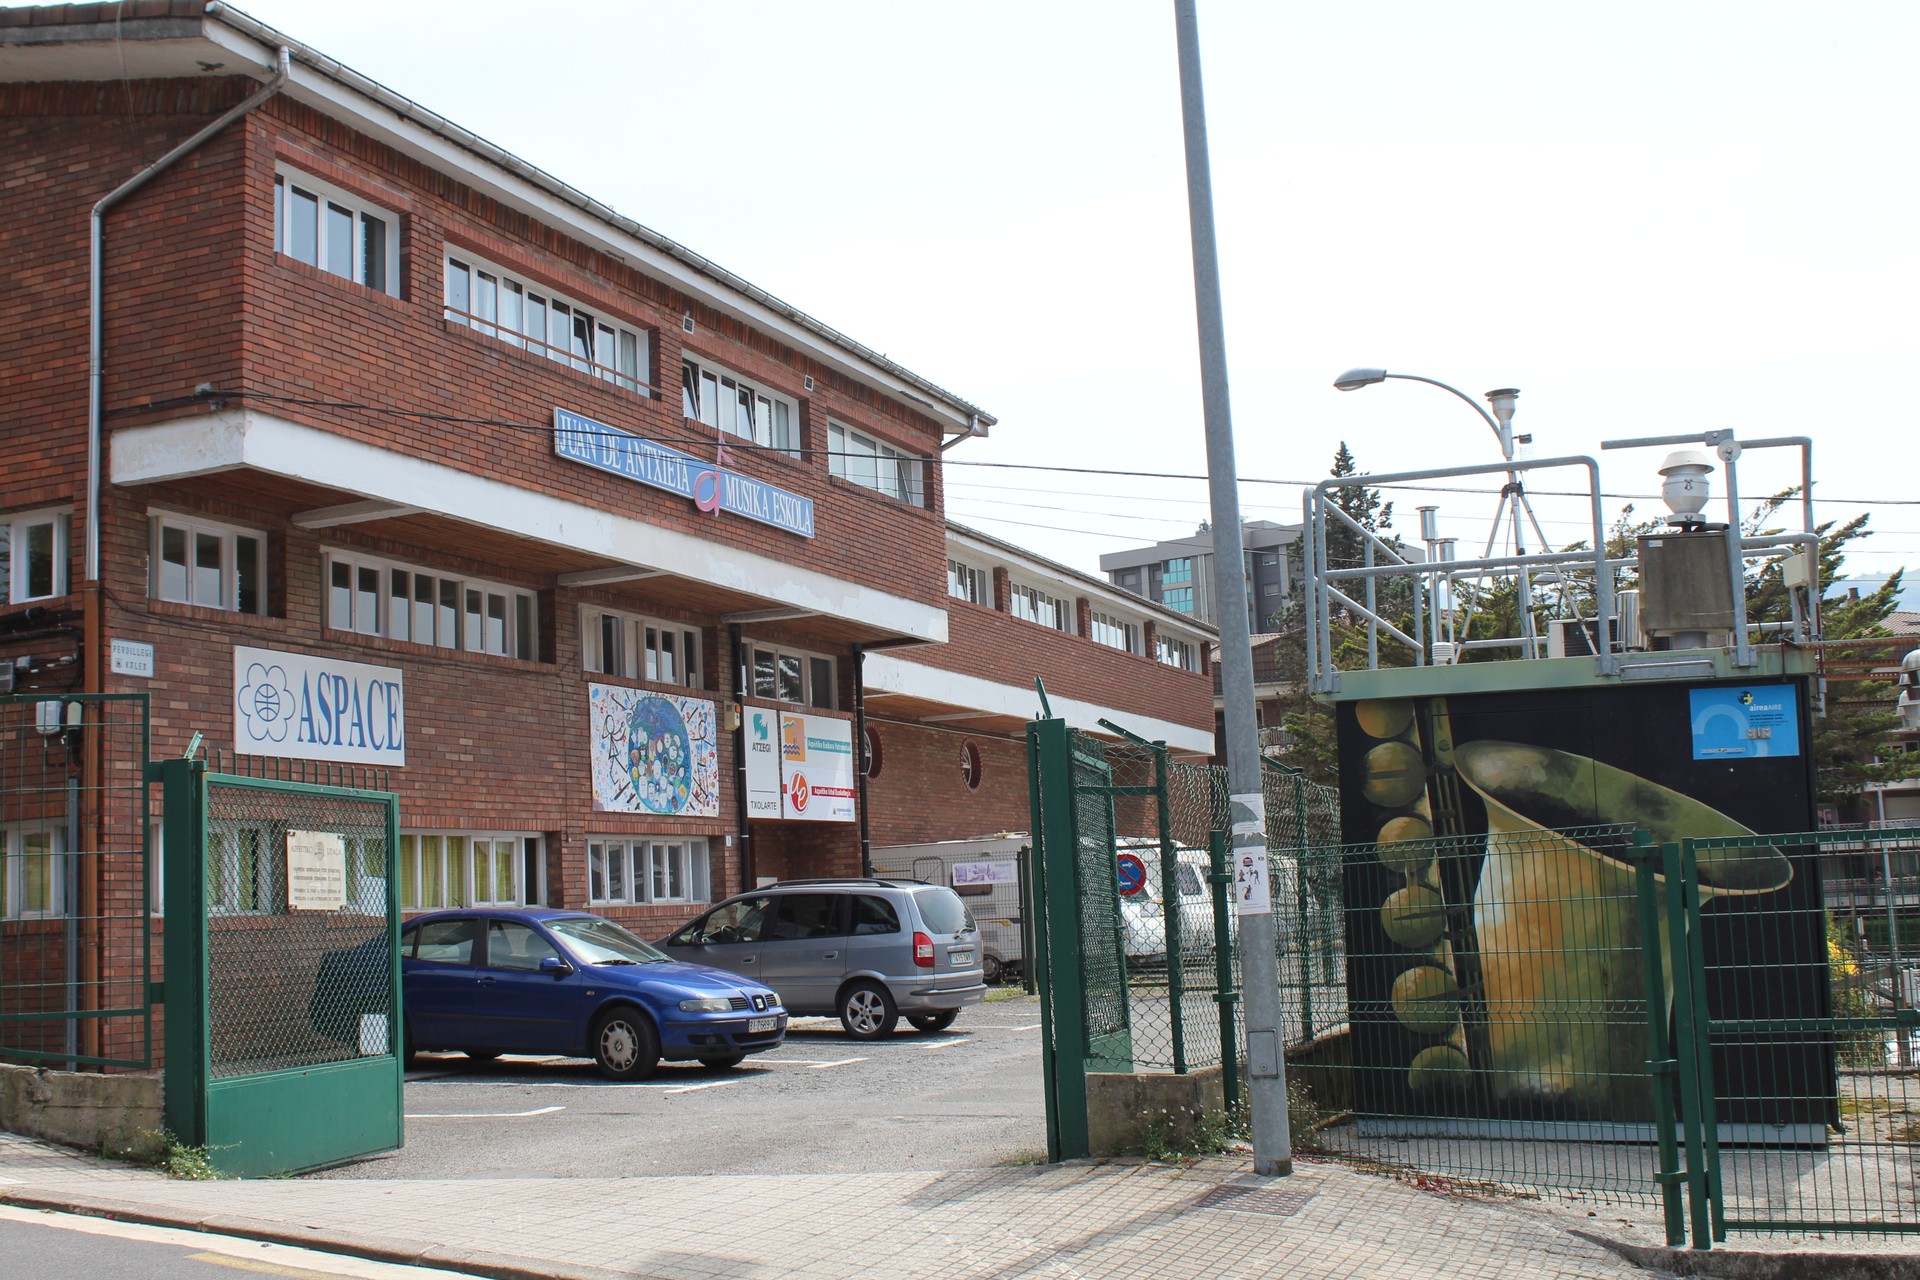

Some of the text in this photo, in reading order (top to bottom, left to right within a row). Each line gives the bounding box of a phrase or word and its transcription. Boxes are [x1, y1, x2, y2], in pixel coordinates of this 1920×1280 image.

[560, 414, 812, 534] JUAN DE ANTXIETA MUSIKA ESKOLA
[297, 669, 401, 751] ASPACE
[752, 742, 771, 753] ATZEGI
[750, 800, 777, 811] TXOLARTE
